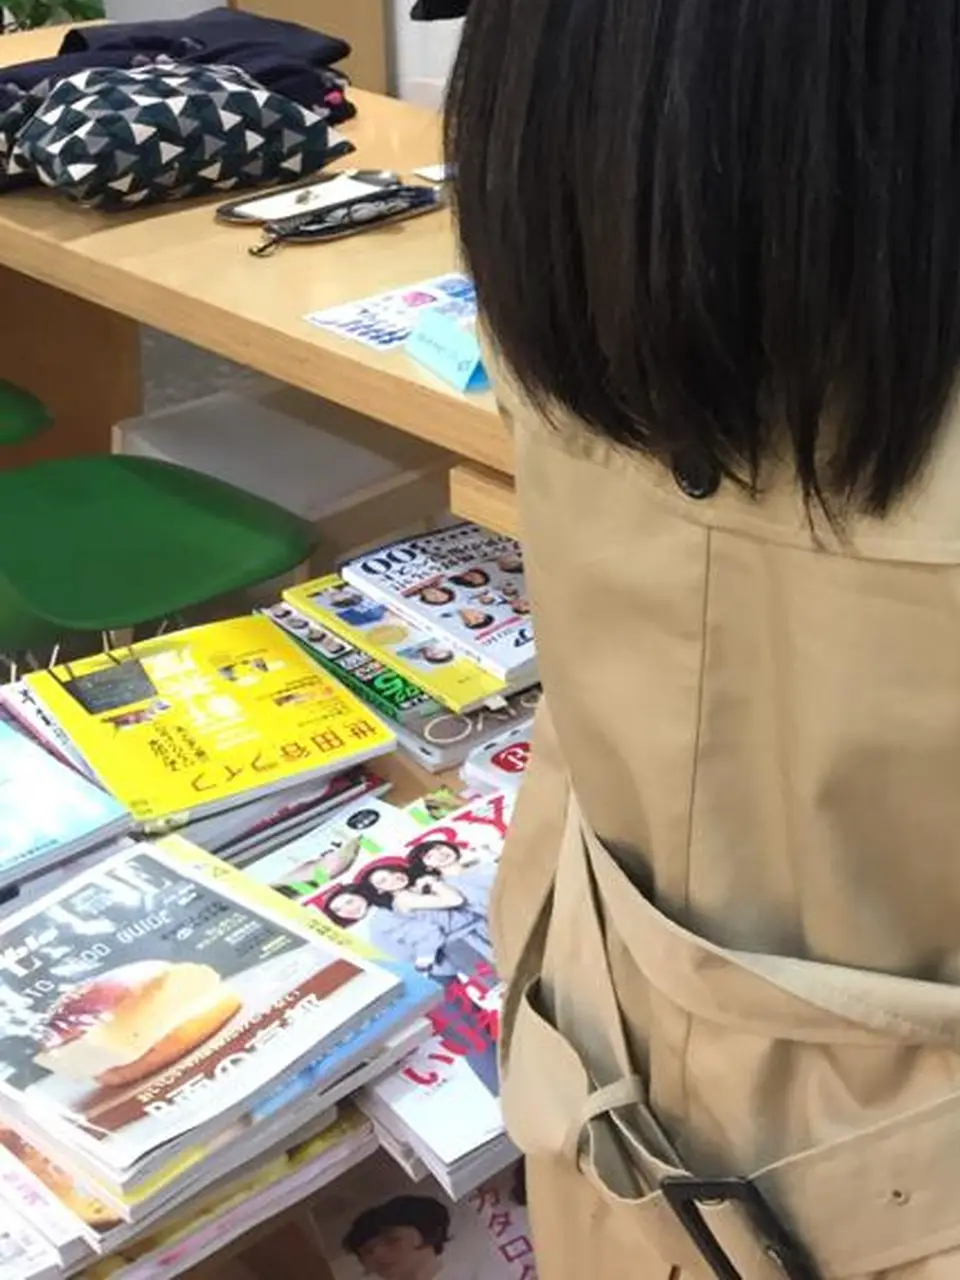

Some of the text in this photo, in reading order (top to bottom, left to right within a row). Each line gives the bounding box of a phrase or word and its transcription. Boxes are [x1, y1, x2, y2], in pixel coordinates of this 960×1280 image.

[190, 718, 377, 793] 世田谷ライフ
